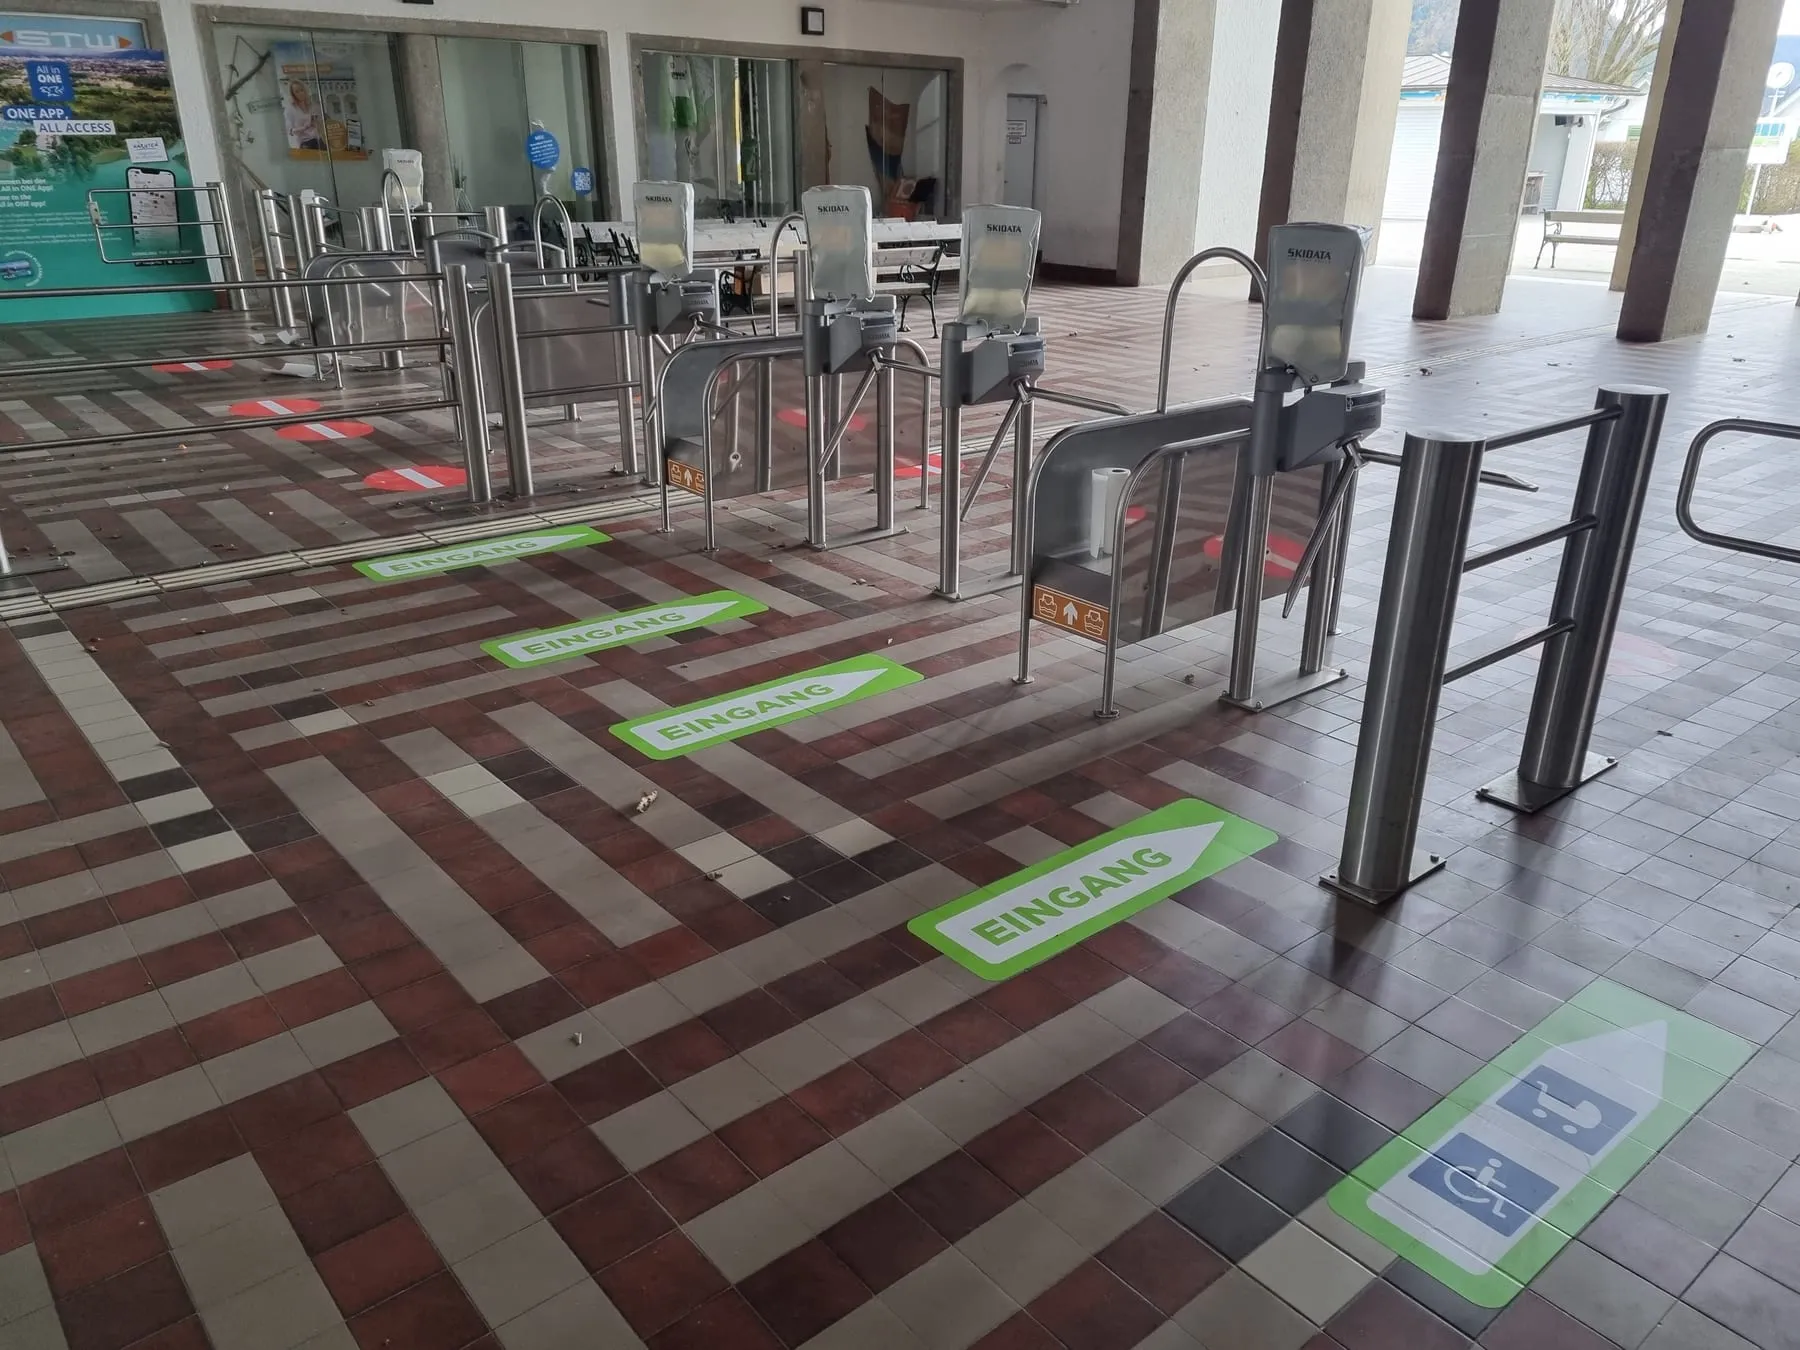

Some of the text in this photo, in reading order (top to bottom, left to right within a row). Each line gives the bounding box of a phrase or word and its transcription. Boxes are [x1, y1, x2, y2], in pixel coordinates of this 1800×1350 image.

[15, 30, 117, 49] STW
[36, 65, 61, 74] All in
[37, 74, 63, 84] ONE
[6, 108, 37, 119] ONE
[39, 122, 112, 133] ALL ACCESS
[817, 205, 850, 213] SKIDATA
[986, 223, 1023, 234] SKIDATA
[1287, 247, 1332, 260] SKIDATA
[388, 541, 537, 572] EINGANG
[521, 612, 686, 655] EINGANG
[657, 683, 834, 741] EINGANG
[970, 848, 1173, 947] EINGANG
